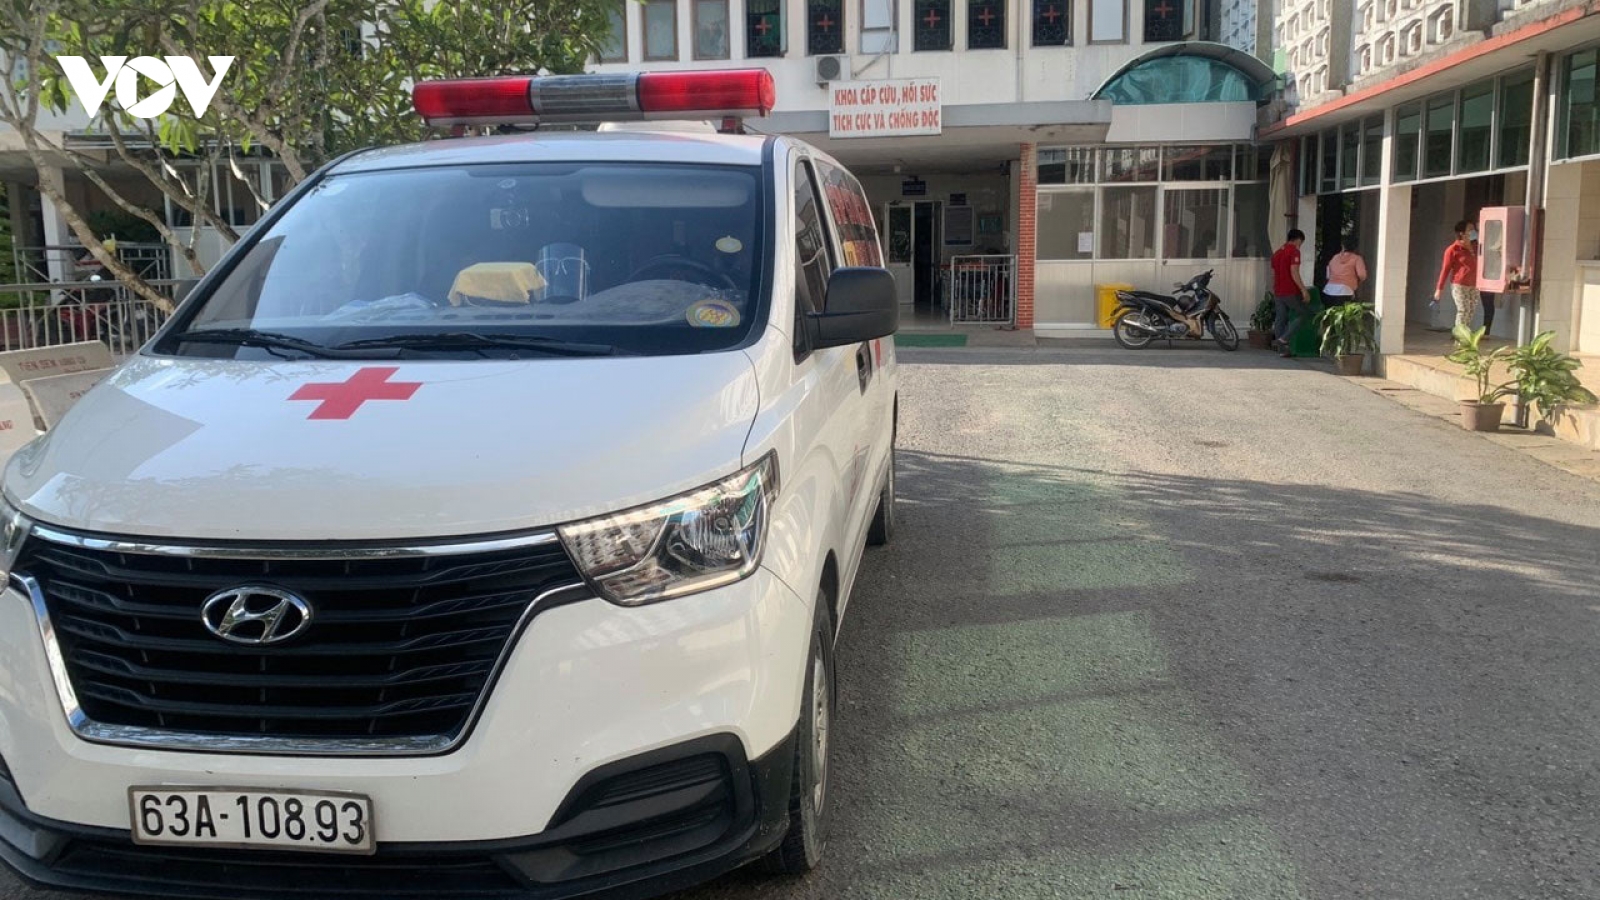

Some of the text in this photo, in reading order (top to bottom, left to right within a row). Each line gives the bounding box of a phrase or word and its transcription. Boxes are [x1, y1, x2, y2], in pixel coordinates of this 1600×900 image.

[834, 89, 858, 106] KHOA
[860, 83, 876, 105] CẤP
[902, 81, 917, 103] HỒI
[920, 82, 937, 103] SỨC
[874, 110, 885, 130] VÀ
[888, 107, 919, 130] CHỐNG
[921, 107, 939, 130] ĐỘC
[140, 794, 365, 845] 63A-108.93
